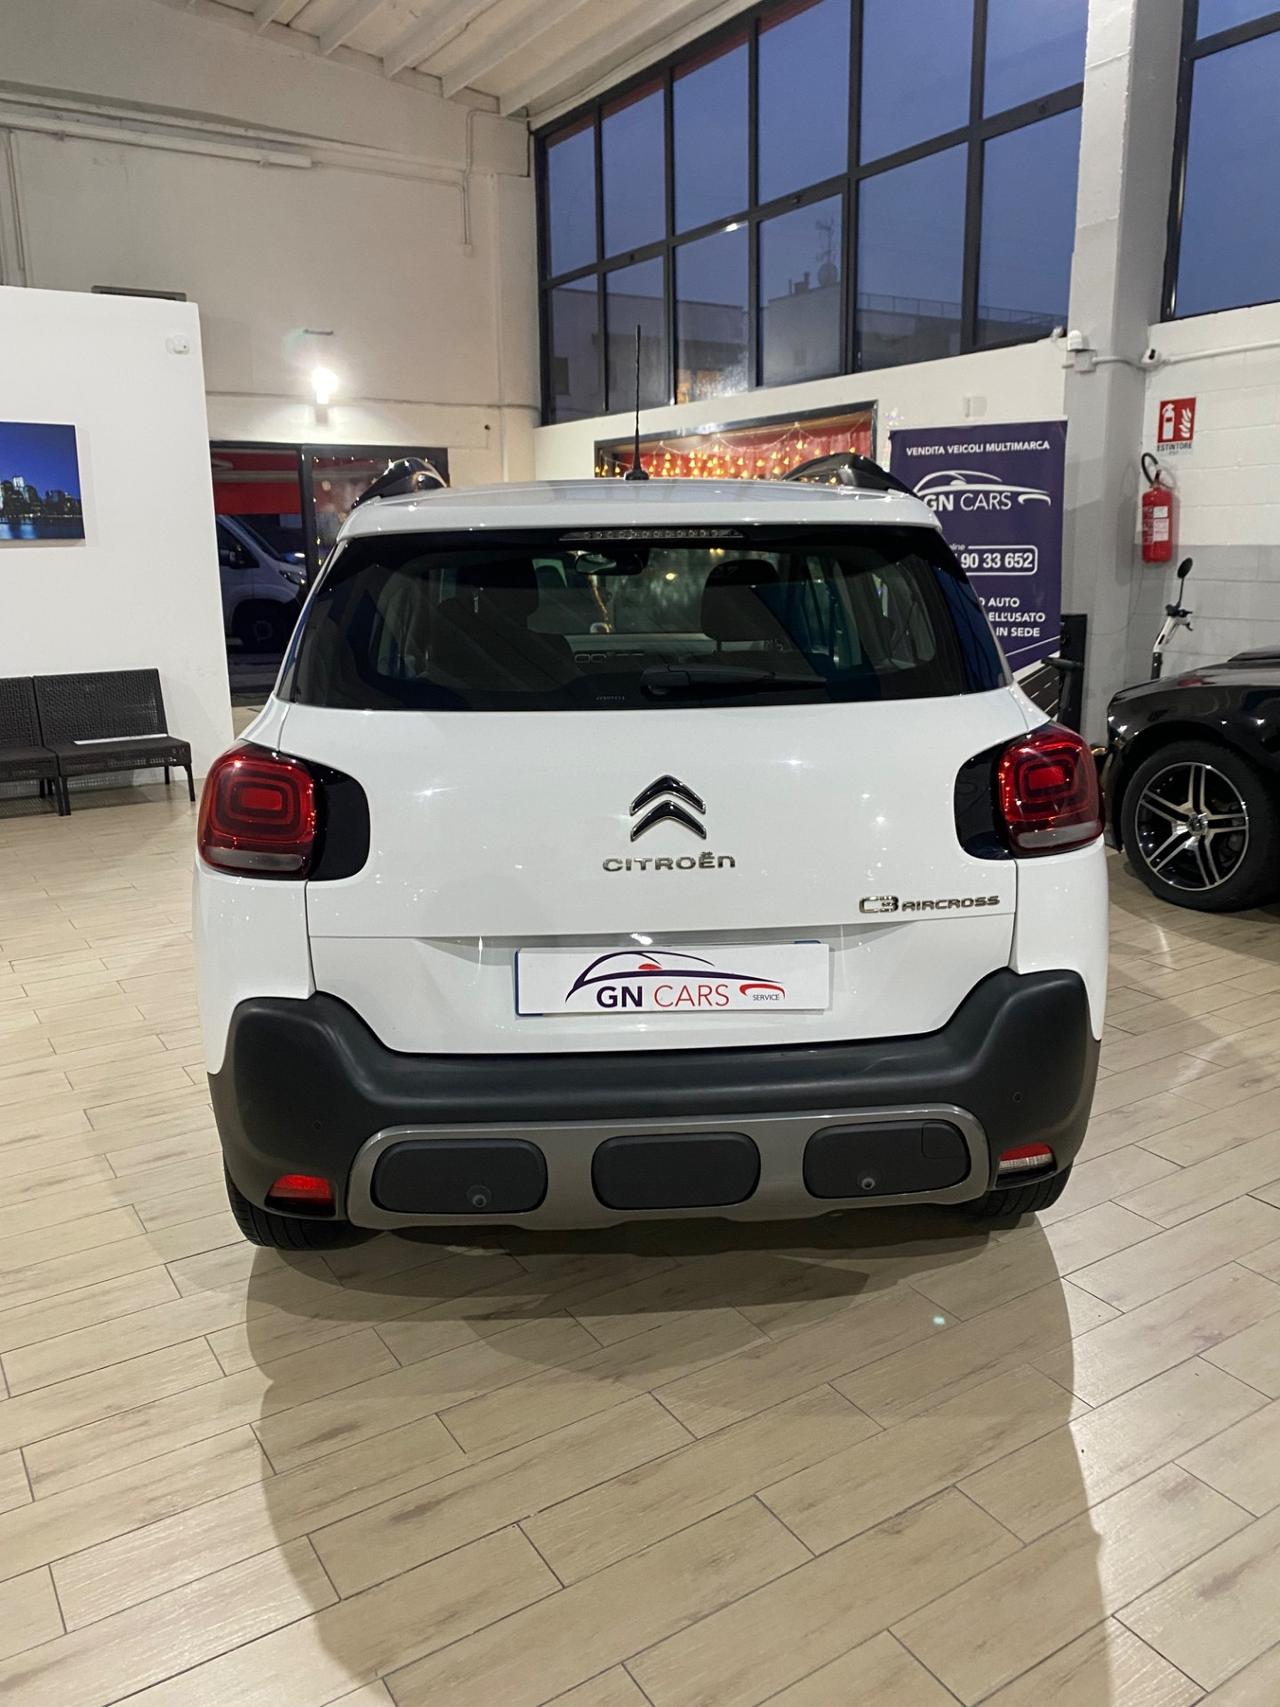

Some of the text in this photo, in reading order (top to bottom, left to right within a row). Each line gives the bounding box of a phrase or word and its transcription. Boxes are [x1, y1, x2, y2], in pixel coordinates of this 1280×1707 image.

[906, 440, 1050, 456] VENDITA VEICOLI MULTIMARCA
[1157, 443, 1192, 452] ESTINTORE
[923, 492, 1012, 511] GN CARS
[961, 552, 1033, 568] 90 33 652
[988, 597, 1020, 607] AUTO
[996, 627, 1040, 636] IN SEDE
[859, 895, 1001, 913] C3 AIRCROSS
[596, 984, 780, 1008] GN CARS SERVICE
